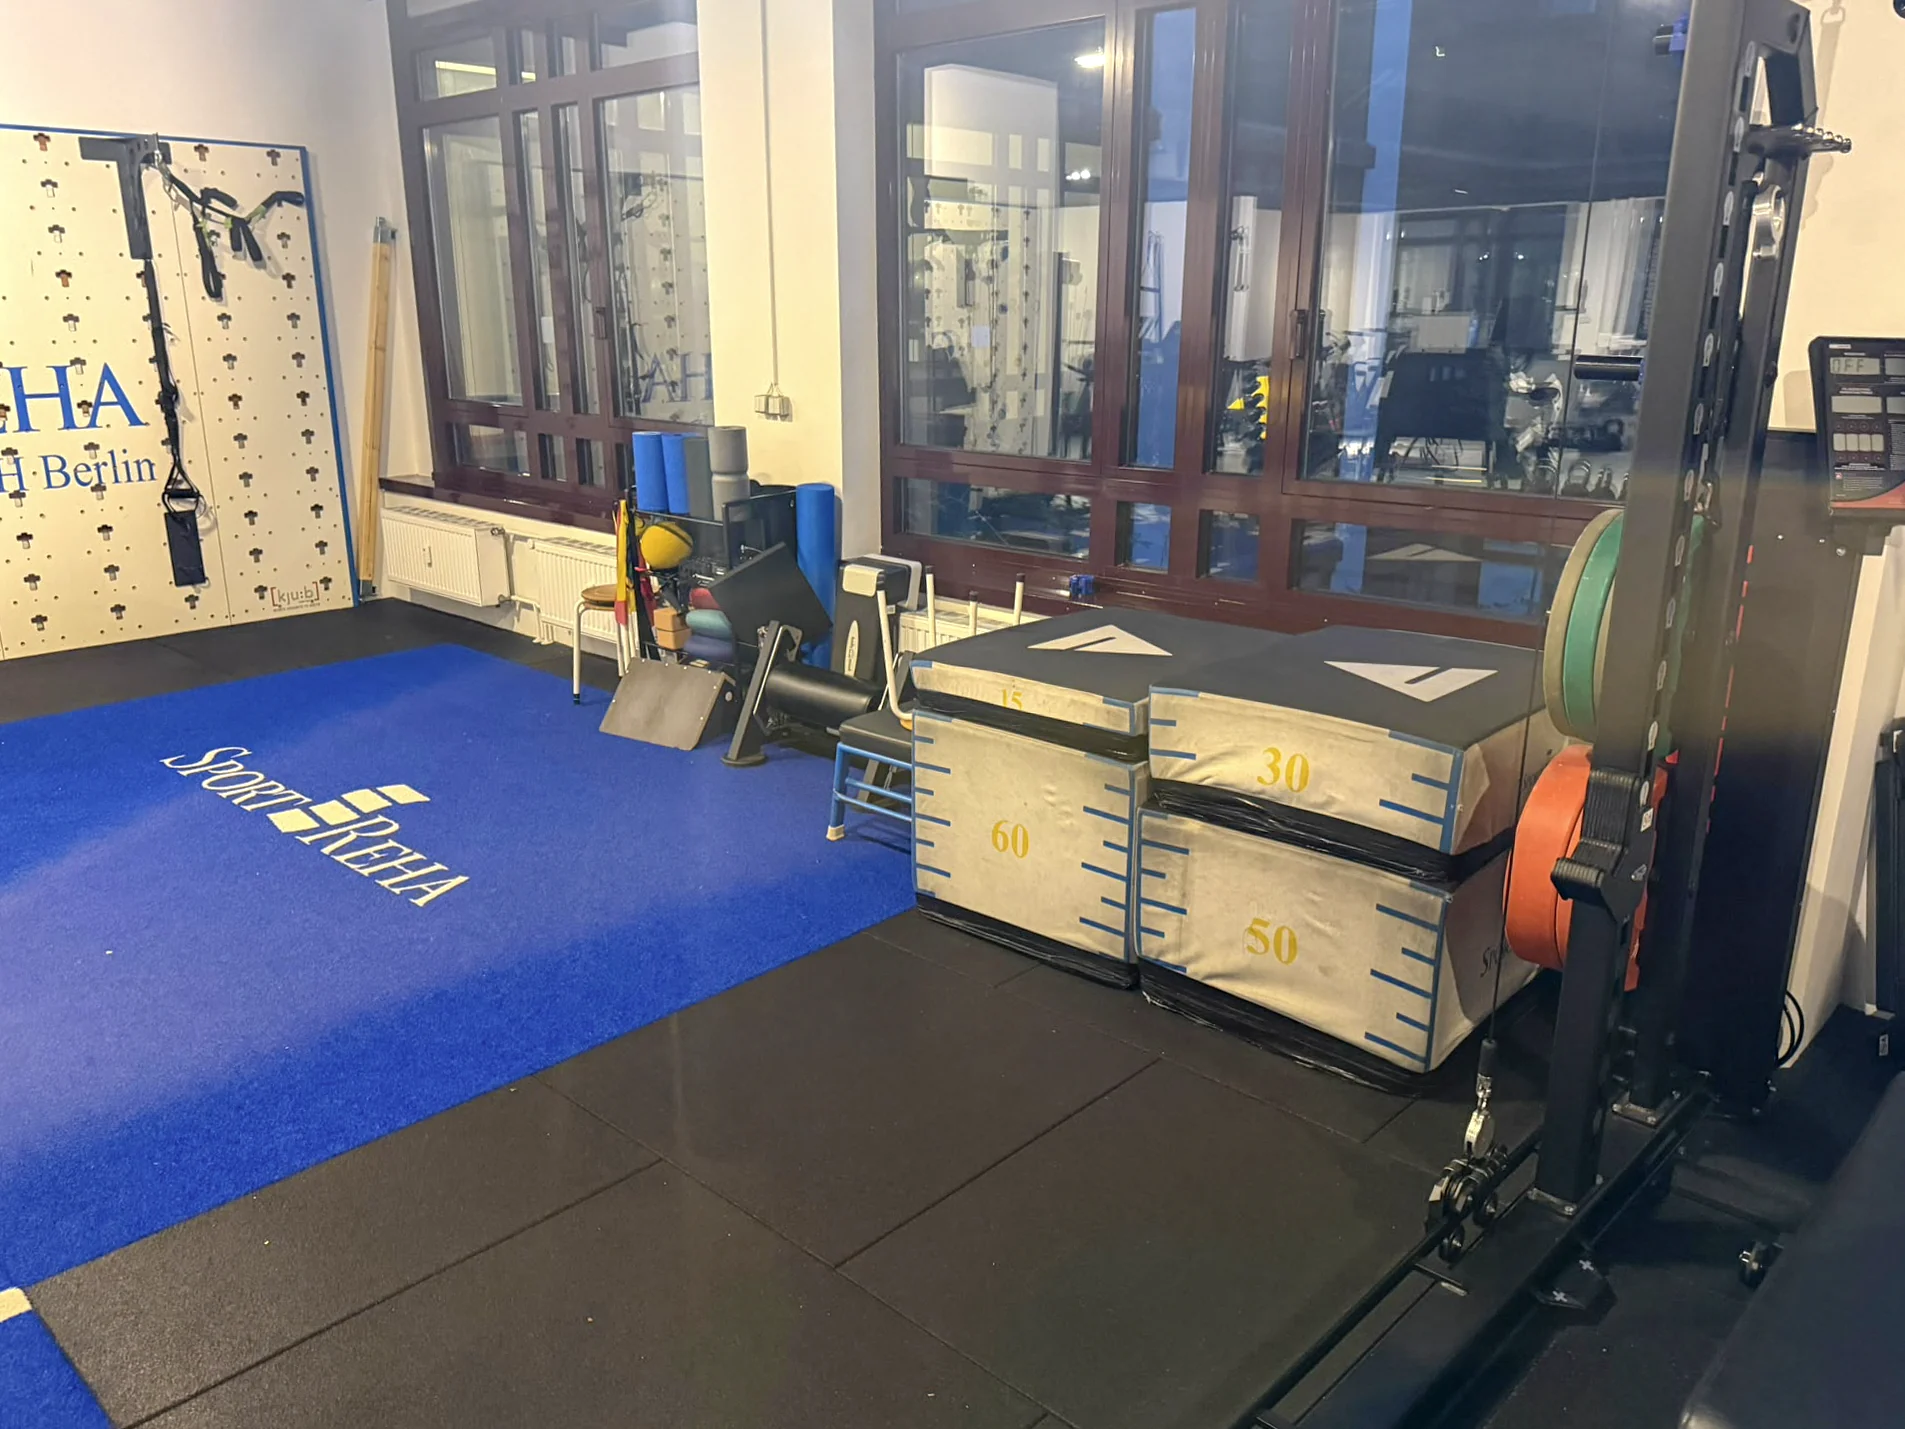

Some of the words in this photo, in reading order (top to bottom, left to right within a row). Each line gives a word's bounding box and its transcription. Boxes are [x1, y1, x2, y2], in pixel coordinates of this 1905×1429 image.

[1832, 358, 1864, 373] OFF
[0, 362, 150, 433] HA
[38, 449, 157, 490] Berlin
[1002, 689, 1023, 710] 15
[159, 746, 312, 811] SPORT
[1257, 747, 1310, 793] 30
[295, 815, 469, 907] REHA
[991, 820, 1029, 859] 60
[1246, 917, 1298, 965] 50
